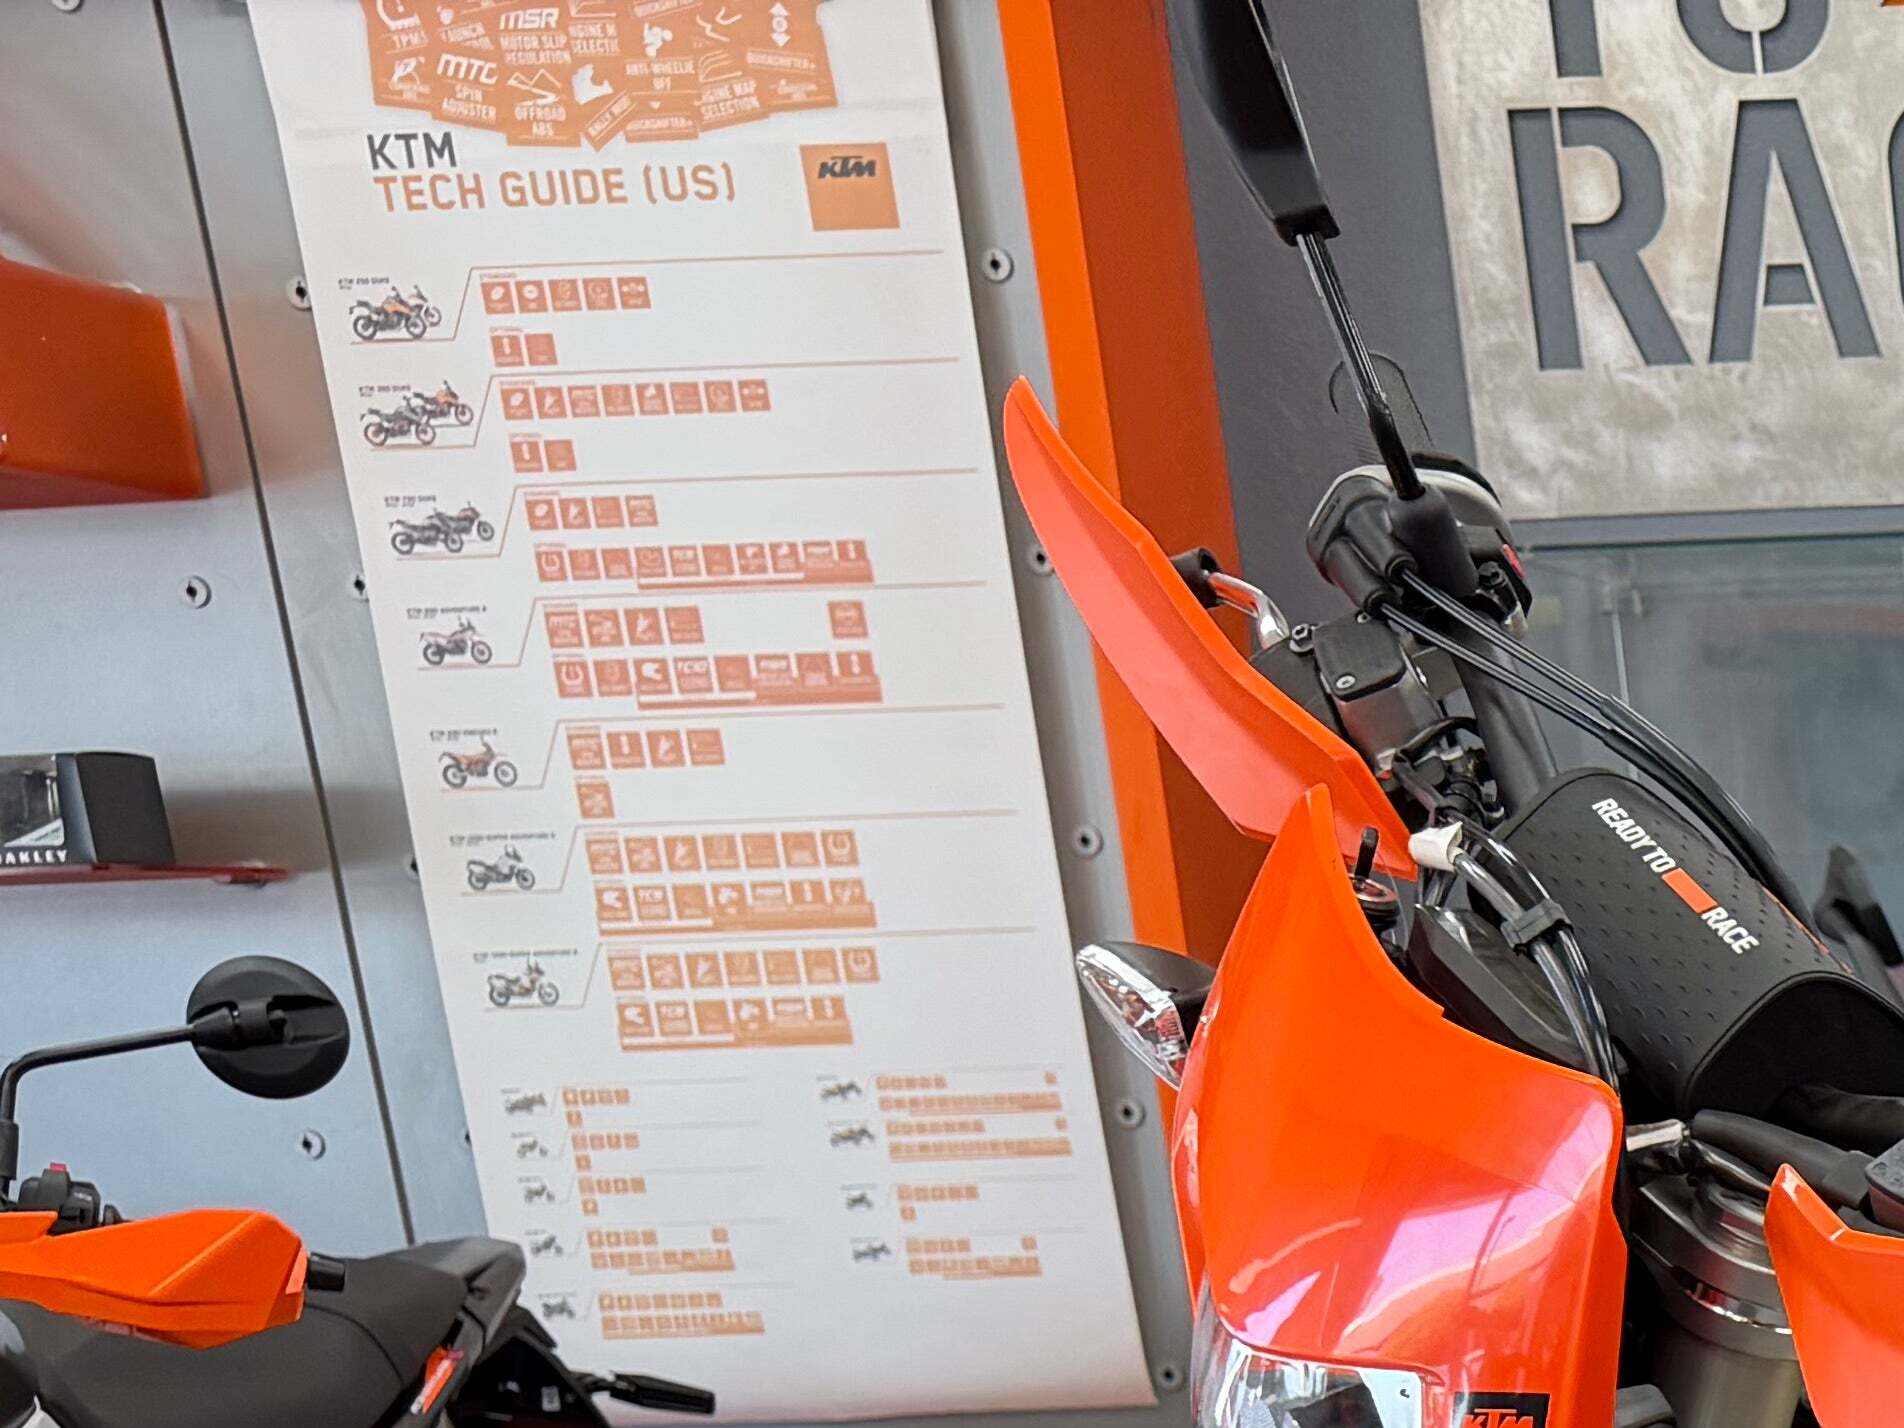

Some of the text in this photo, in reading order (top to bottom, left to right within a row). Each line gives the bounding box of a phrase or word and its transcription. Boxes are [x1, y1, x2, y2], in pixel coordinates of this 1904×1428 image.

[499, 8, 559, 31] MSR
[436, 53, 498, 85] MTC
[367, 131, 457, 170] KTM
[818, 155, 876, 180] KTM
[374, 161, 736, 213] TECH GUIDE (US)
[0, 849, 67, 865] AKLEY
[1592, 798, 1760, 954] READY TO RACE
